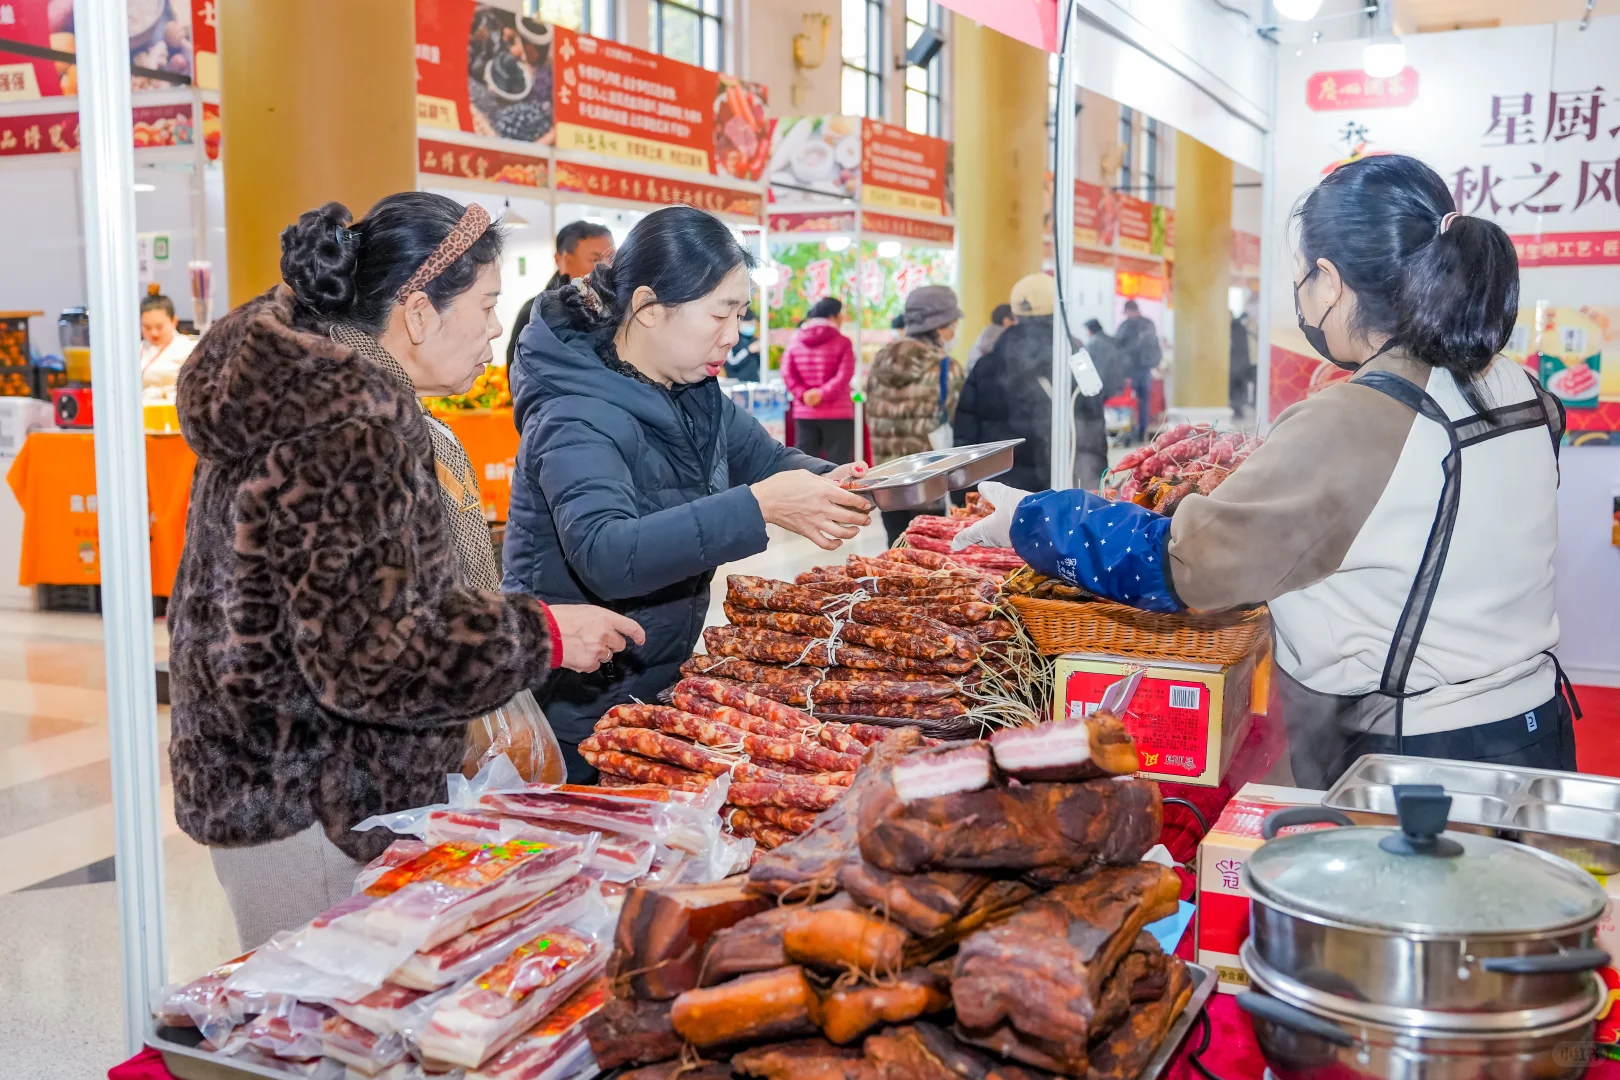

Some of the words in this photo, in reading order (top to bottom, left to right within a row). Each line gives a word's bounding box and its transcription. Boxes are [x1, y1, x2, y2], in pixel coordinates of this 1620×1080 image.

[0, 122, 80, 151] 品博览
[1481, 85, 1620, 147] 星厨
[1447, 157, 1620, 216] 秋之风
